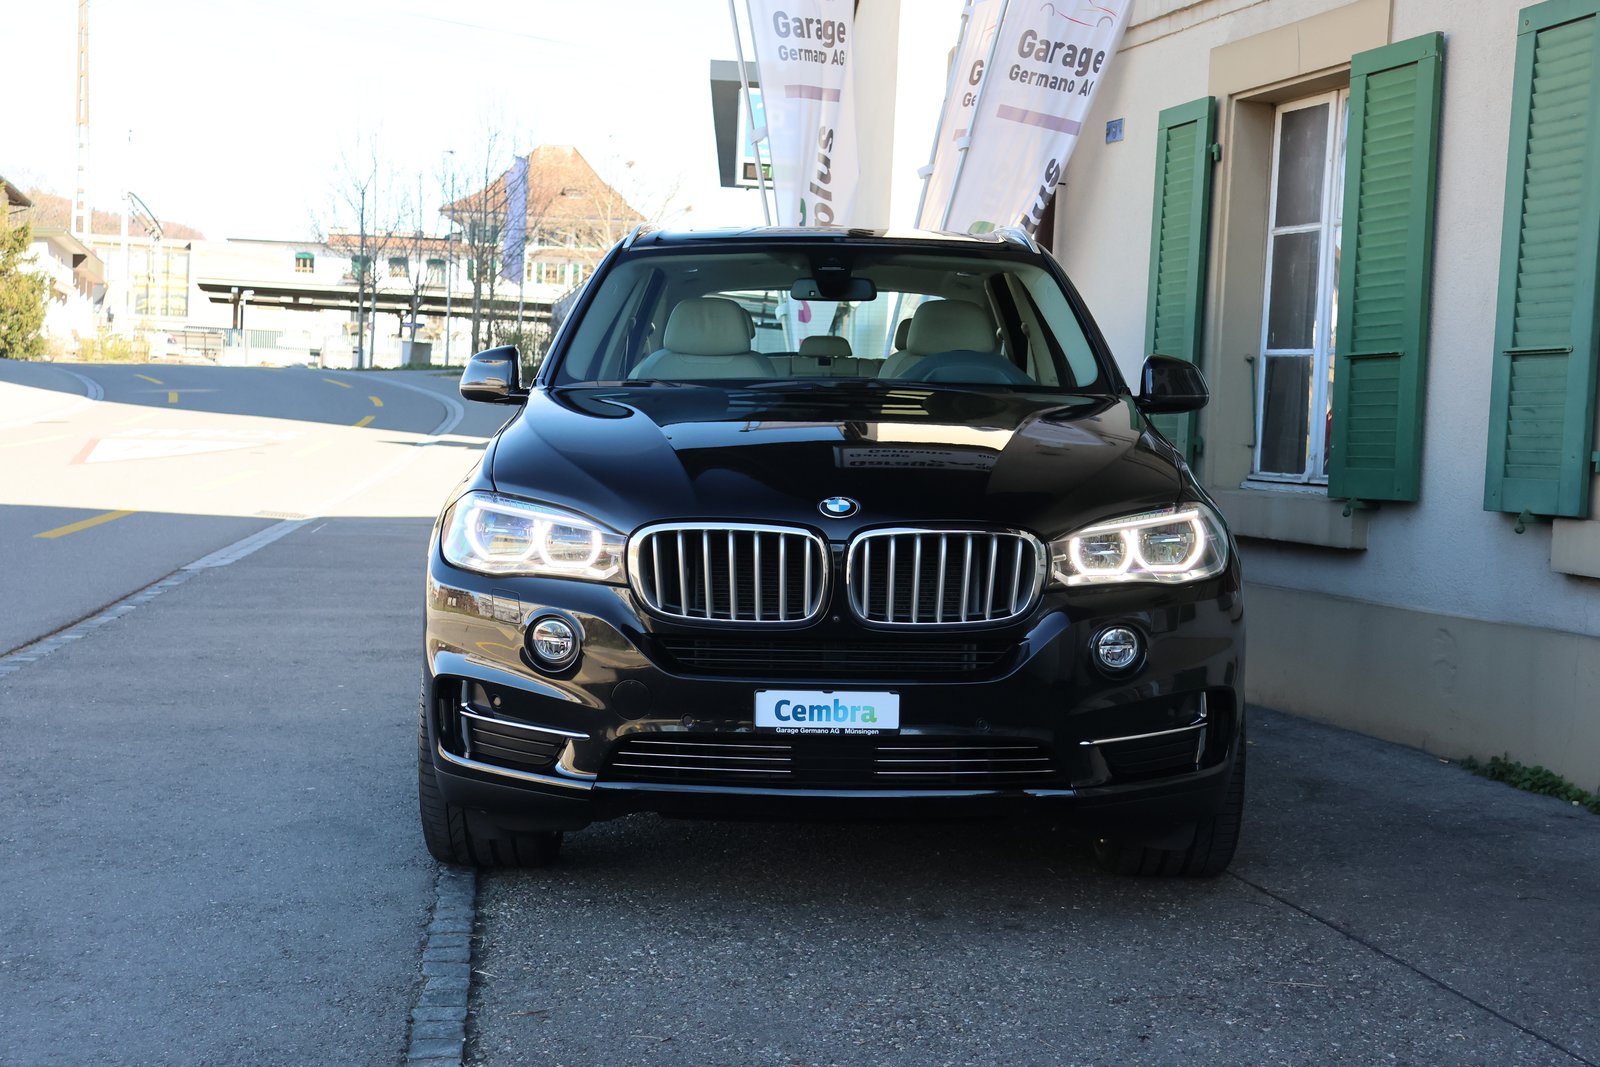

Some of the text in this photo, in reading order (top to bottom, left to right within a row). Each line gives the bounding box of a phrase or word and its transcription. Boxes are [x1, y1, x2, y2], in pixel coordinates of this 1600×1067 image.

[773, 10, 846, 48] Garage
[831, 49, 845, 66] AG
[1017, 29, 1106, 77] Garage
[1008, 63, 1075, 93] Germano
[774, 698, 878, 723] Cembra
[775, 727, 799, 735] Garage
[844, 728, 879, 736] Münsingen
